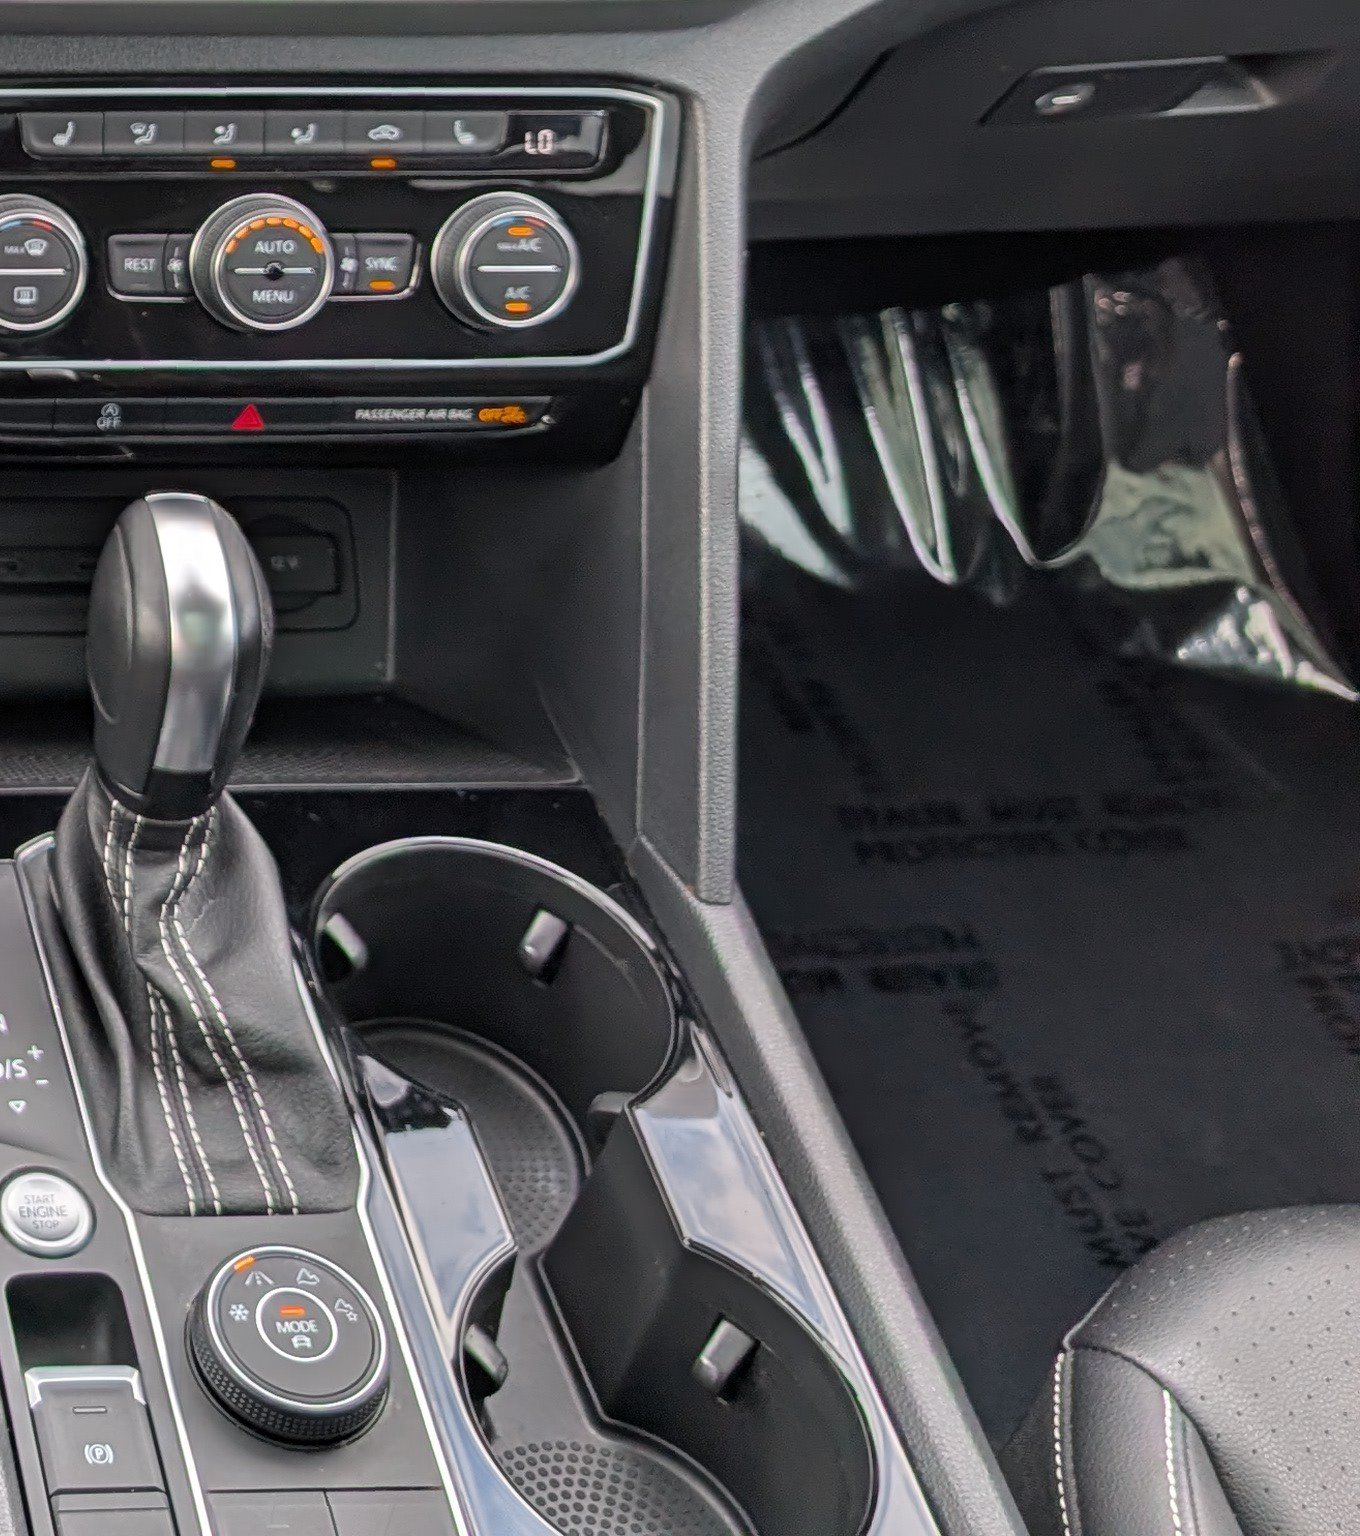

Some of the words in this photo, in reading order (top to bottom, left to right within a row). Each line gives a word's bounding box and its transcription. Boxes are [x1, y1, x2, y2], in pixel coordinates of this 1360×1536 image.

[3, 244, 24, 256] MAX
[254, 240, 296, 255] AUTO
[123, 257, 156, 273] REST
[364, 255, 398, 272] SYNC
[252, 288, 295, 305] MENU
[354, 408, 427, 421] PASSENGER
[426, 408, 448, 421] AIR
[448, 408, 474, 421] BAG
[96, 416, 122, 431] OFF
[24, 1192, 55, 1206] START
[18, 1204, 68, 1219] ENGINE
[31, 1217, 60, 1231] STOP
[275, 1319, 319, 1335] MODE
